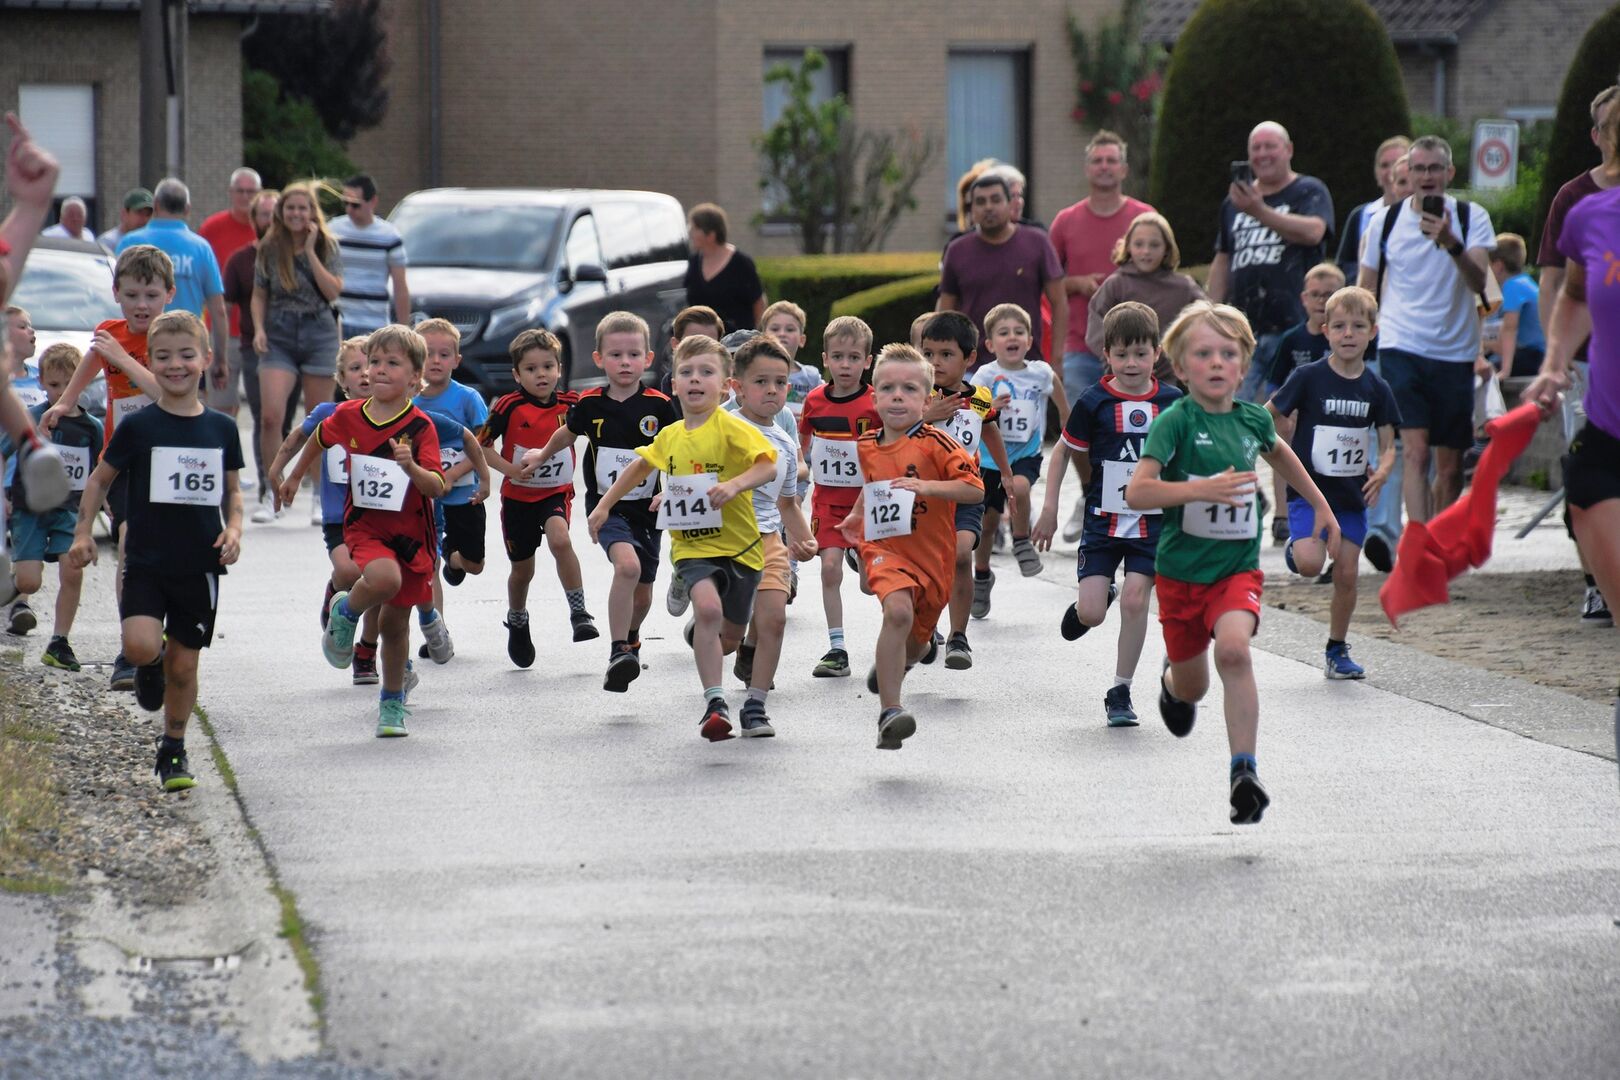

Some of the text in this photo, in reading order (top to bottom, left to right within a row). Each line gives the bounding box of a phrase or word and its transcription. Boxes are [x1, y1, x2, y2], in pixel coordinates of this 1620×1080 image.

[1325, 399, 1370, 417] PUMA
[592, 418, 604, 438] 7
[1327, 449, 1364, 465] 112
[64, 466, 84, 480] 30
[820, 459, 857, 476] 113
[168, 472, 216, 492] 165
[357, 480, 394, 499] 132
[663, 498, 707, 516] 114
[871, 503, 901, 524] 122
[1205, 501, 1253, 523] 117
